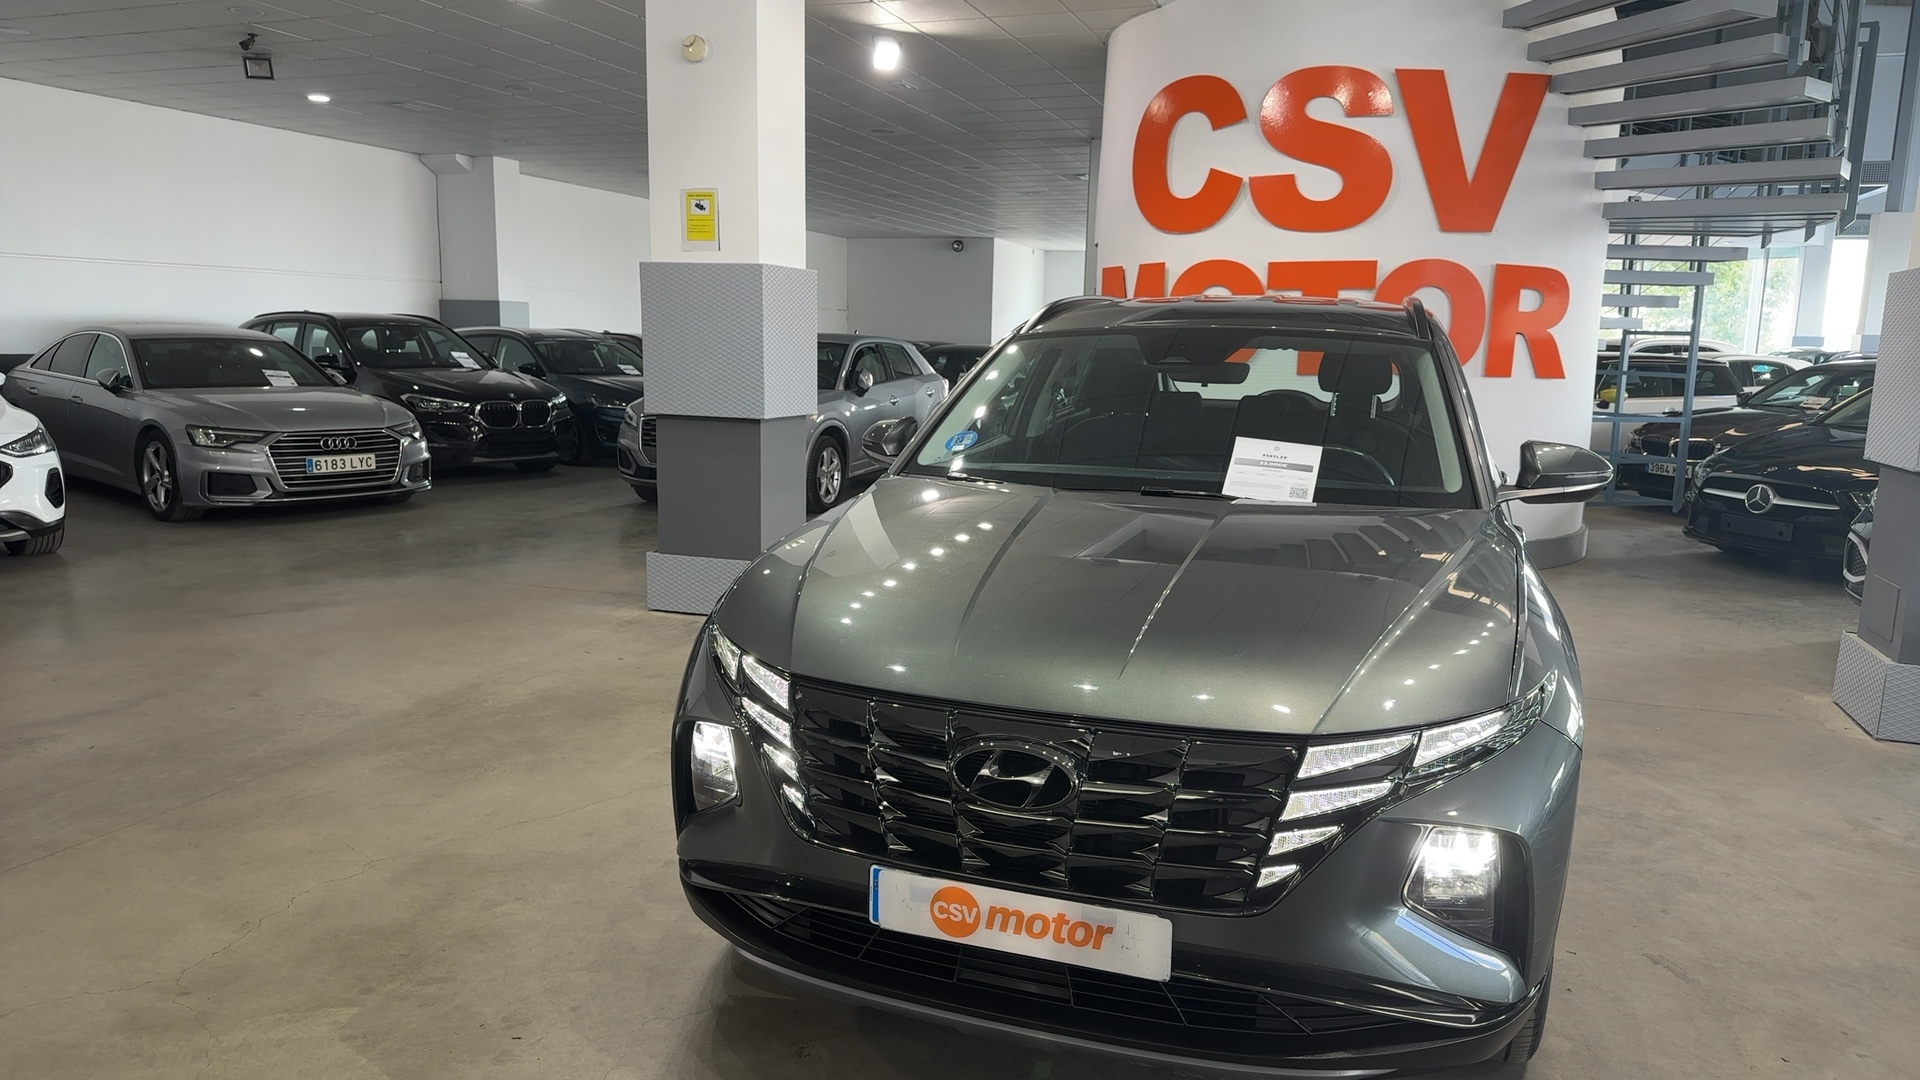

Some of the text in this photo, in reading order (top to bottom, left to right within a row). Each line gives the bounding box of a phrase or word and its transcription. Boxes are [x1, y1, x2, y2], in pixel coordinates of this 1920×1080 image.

[1133, 66, 1552, 233] CSV
[1102, 259, 1570, 378] TOR
[315, 456, 372, 471] 6183 LYC
[1650, 463, 1670, 474] 3964
[985, 905, 1114, 950] motor
